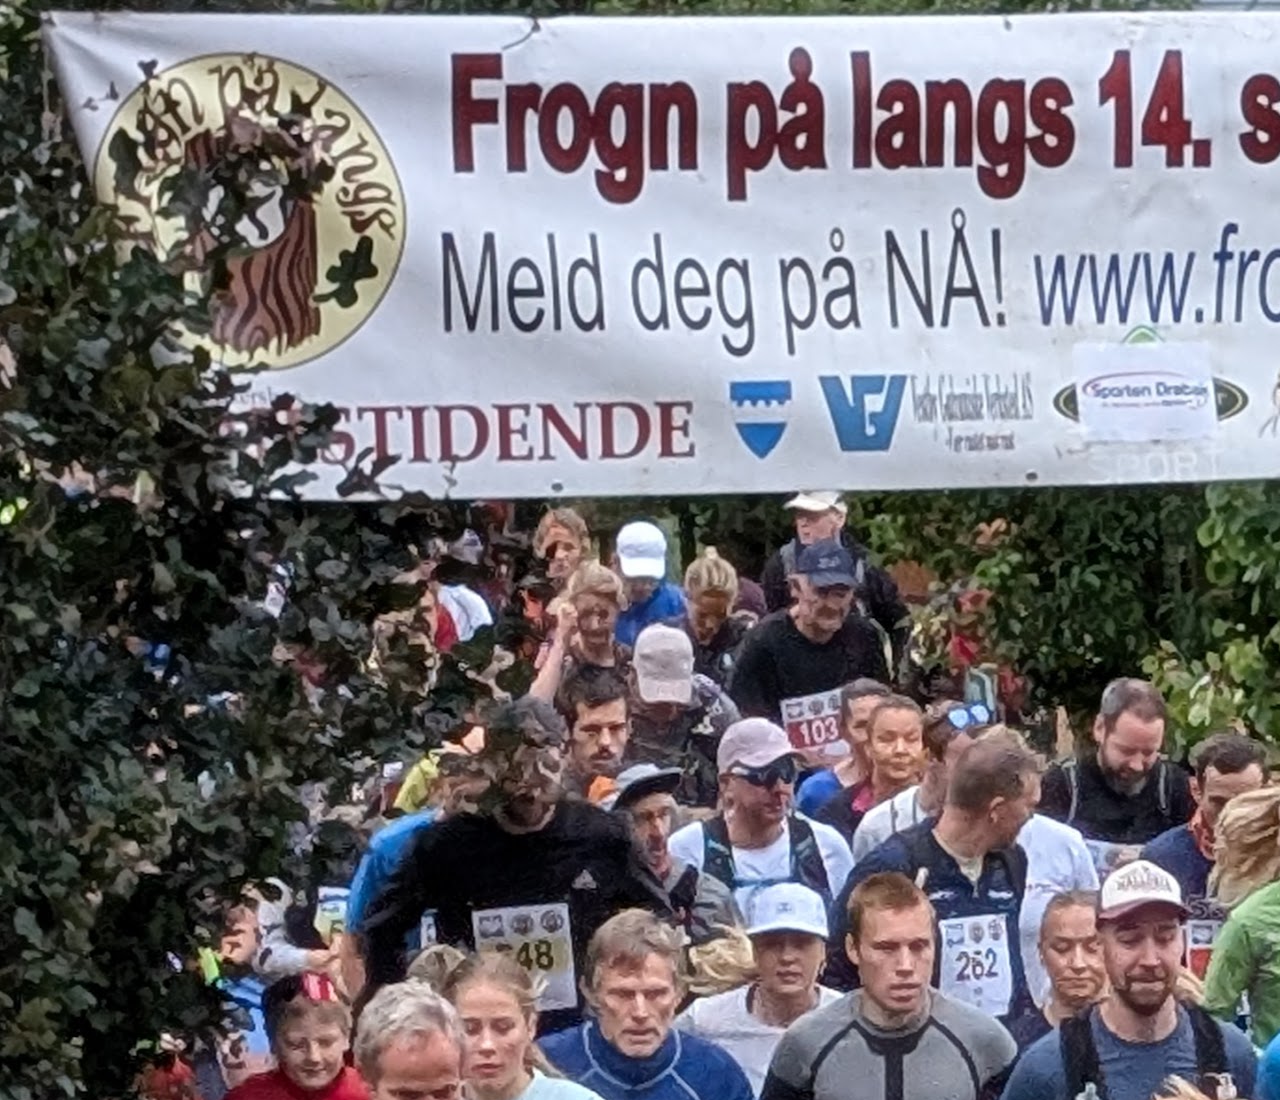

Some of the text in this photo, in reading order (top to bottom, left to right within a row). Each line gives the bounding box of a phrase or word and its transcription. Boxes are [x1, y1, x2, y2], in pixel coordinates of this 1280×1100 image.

[451, 53, 698, 204] Frogn
[726, 47, 828, 201] på
[851, 51, 1075, 199] langs
[1099, 50, 1212, 168] 14.
[441, 233, 606, 333] Meld
[631, 234, 755, 356] deg
[779, 228, 861, 355] på
[885, 207, 1006, 328] NÅ!
[222, 401, 696, 466] STIDENDE
[800, 716, 839, 745] 103
[496, 939, 554, 971] 48
[955, 948, 999, 981] 262
